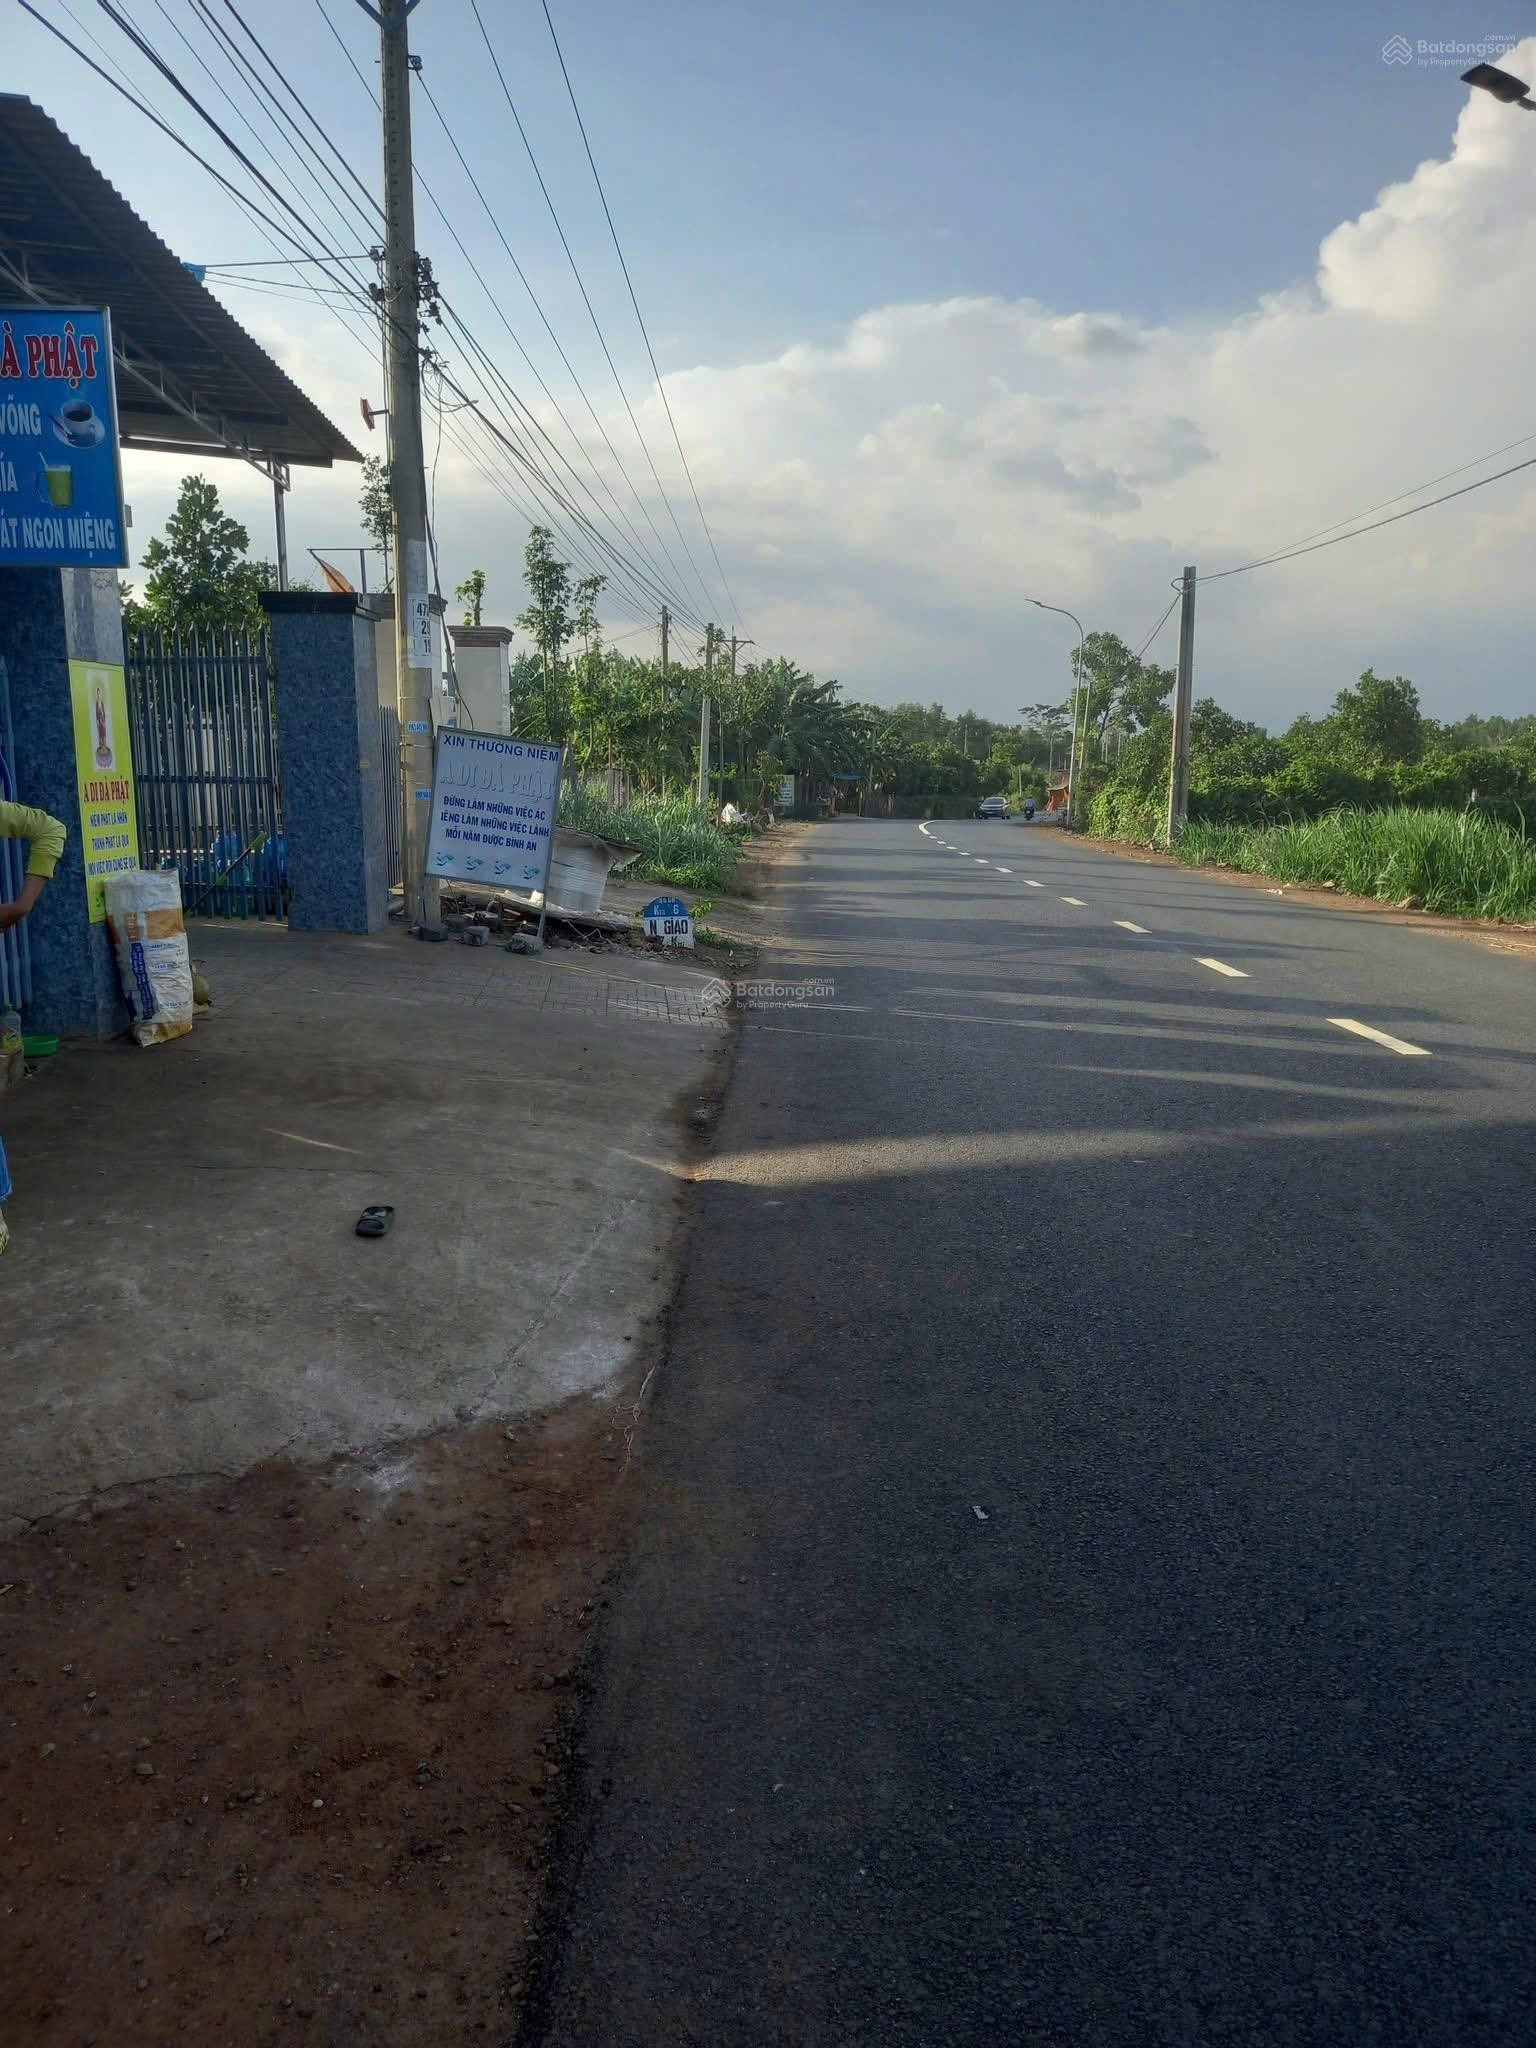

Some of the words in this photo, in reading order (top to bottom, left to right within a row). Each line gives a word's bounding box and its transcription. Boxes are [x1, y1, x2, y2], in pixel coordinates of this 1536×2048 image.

[24, 320, 99, 389] PHẬT
[0, 452, 18, 492] ÍA
[22, 517, 65, 549] NGON
[67, 511, 116, 558] MIỆNG
[443, 735, 465, 748] XIN
[469, 739, 523, 756] THƯỜNG
[527, 747, 559, 763] NIỆM
[467, 798, 484, 811] LÀM
[515, 805, 533, 819] VIỆC
[509, 821, 527, 834] VIỆC
[526, 842, 537, 851] AN
